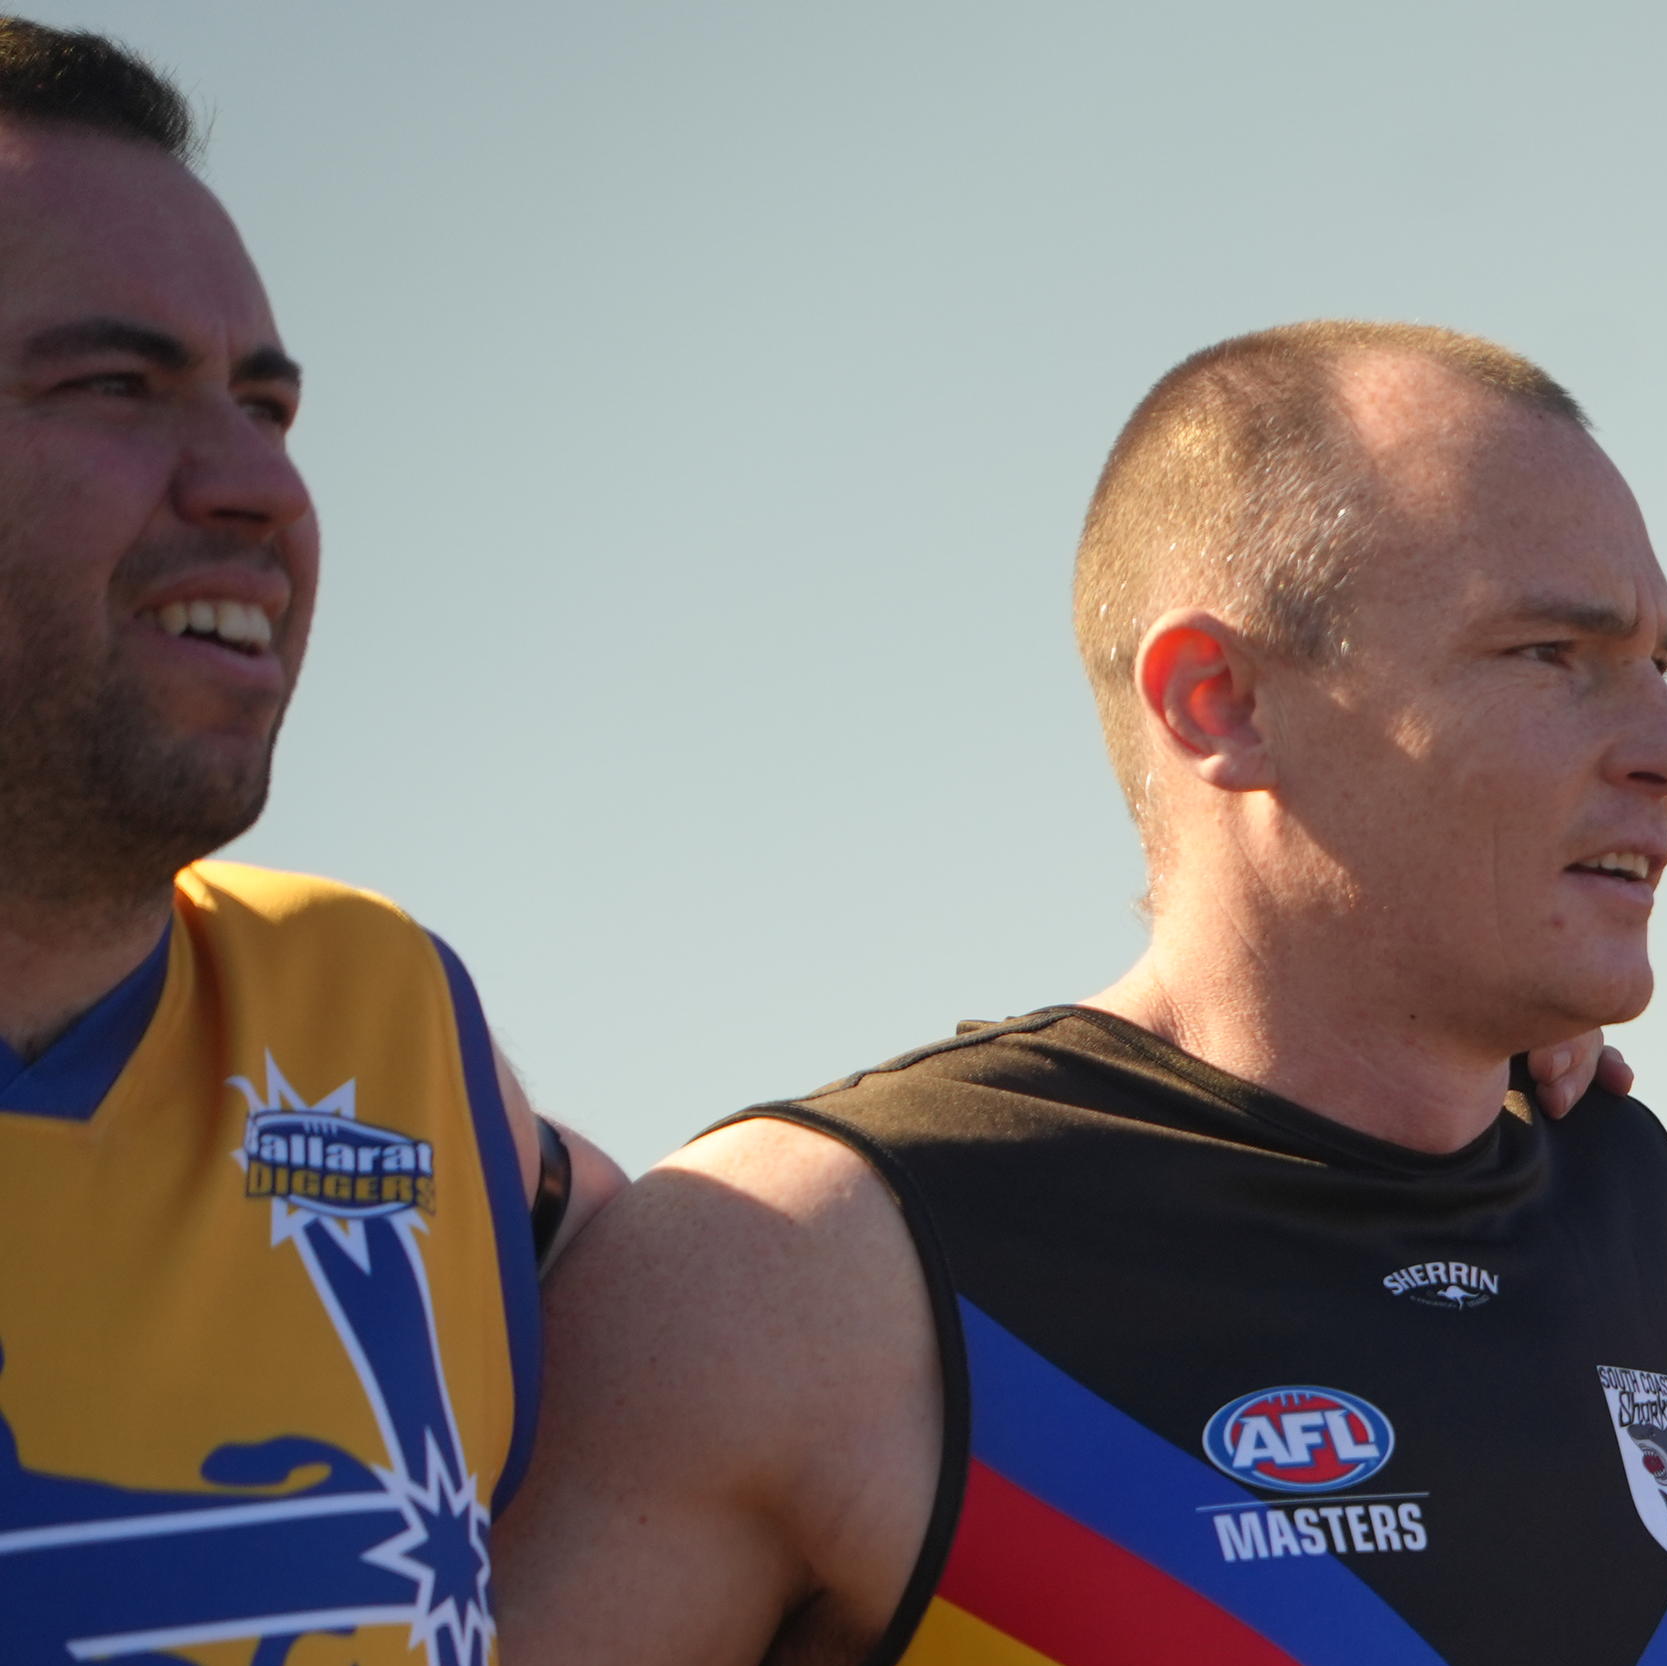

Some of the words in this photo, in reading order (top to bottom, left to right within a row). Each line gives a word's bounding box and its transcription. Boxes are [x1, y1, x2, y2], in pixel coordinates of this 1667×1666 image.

[1383, 1261, 1499, 1295] SHERRIN
[1599, 1366, 1640, 1392] SOUTH
[1233, 1408, 1380, 1469] AFL
[1213, 1503, 1429, 1562] MASTERS
